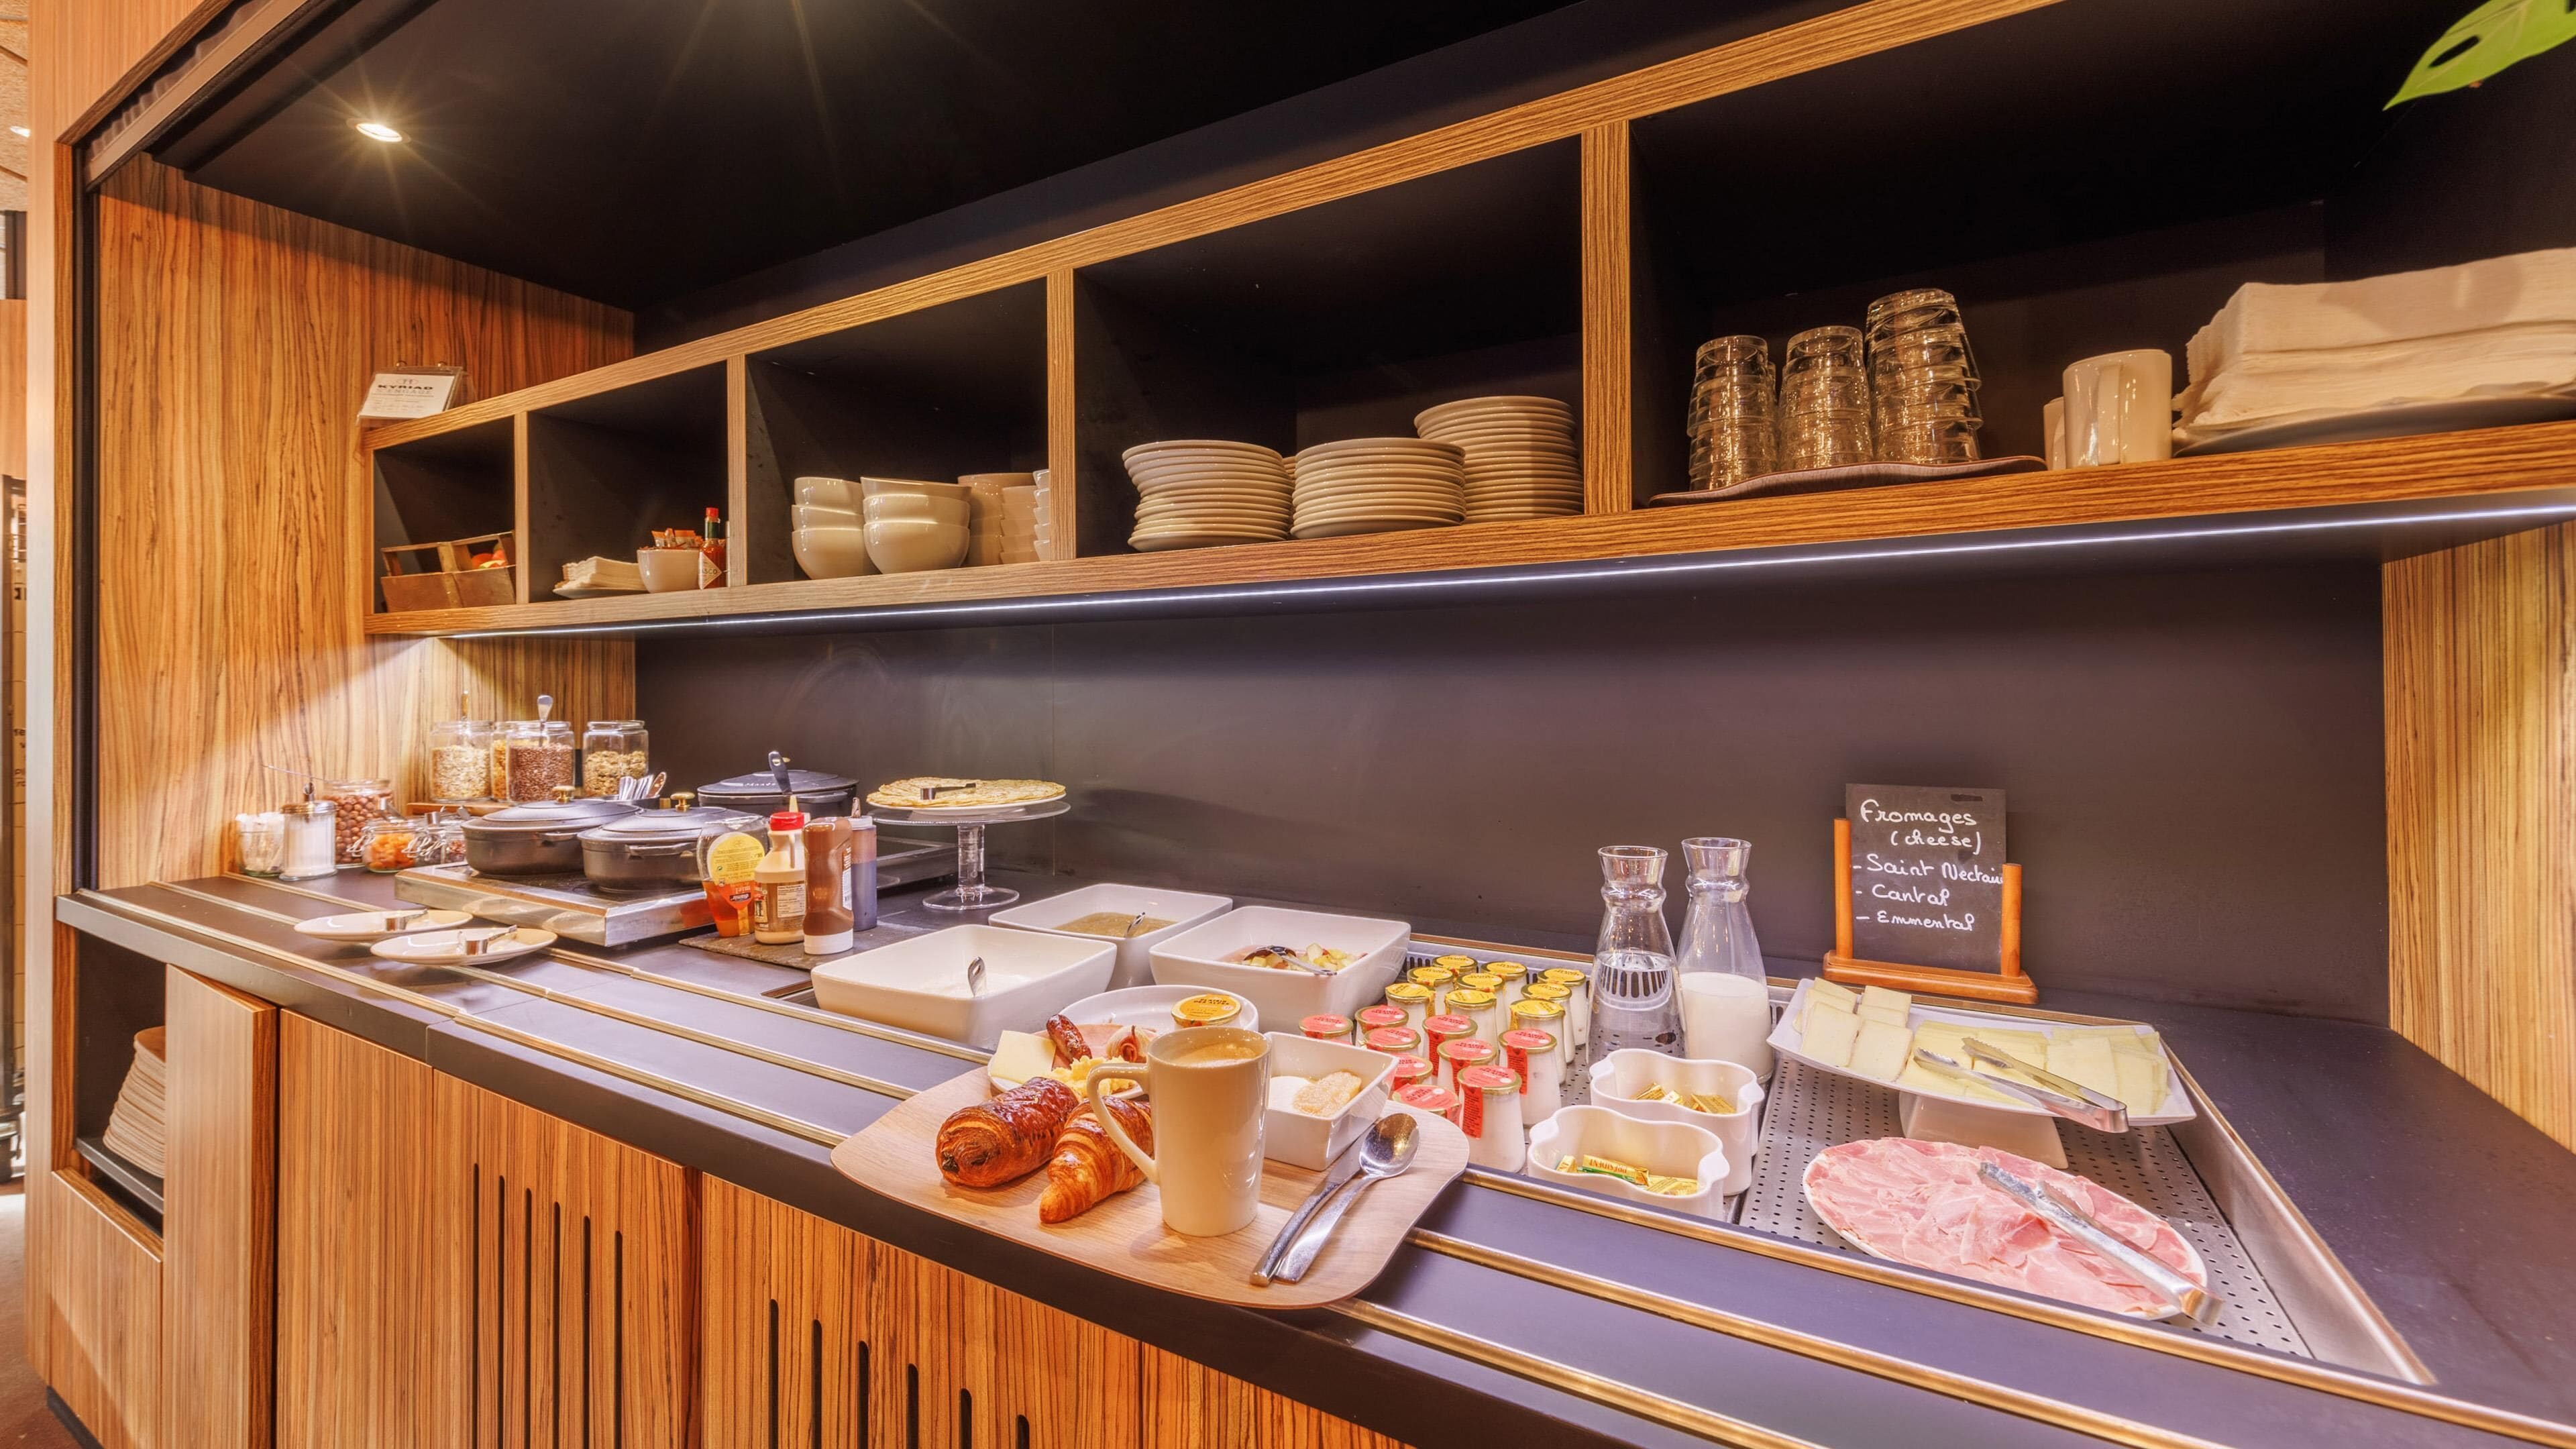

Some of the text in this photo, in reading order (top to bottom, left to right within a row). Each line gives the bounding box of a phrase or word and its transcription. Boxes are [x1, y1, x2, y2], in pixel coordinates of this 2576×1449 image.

[1860, 799, 1977, 834] Fromages
[1890, 829, 1981, 855] (cheese)
[1867, 853, 1934, 875] Saint
[1872, 883, 1949, 906] Cantal
[1877, 910, 1975, 931] Emmental
